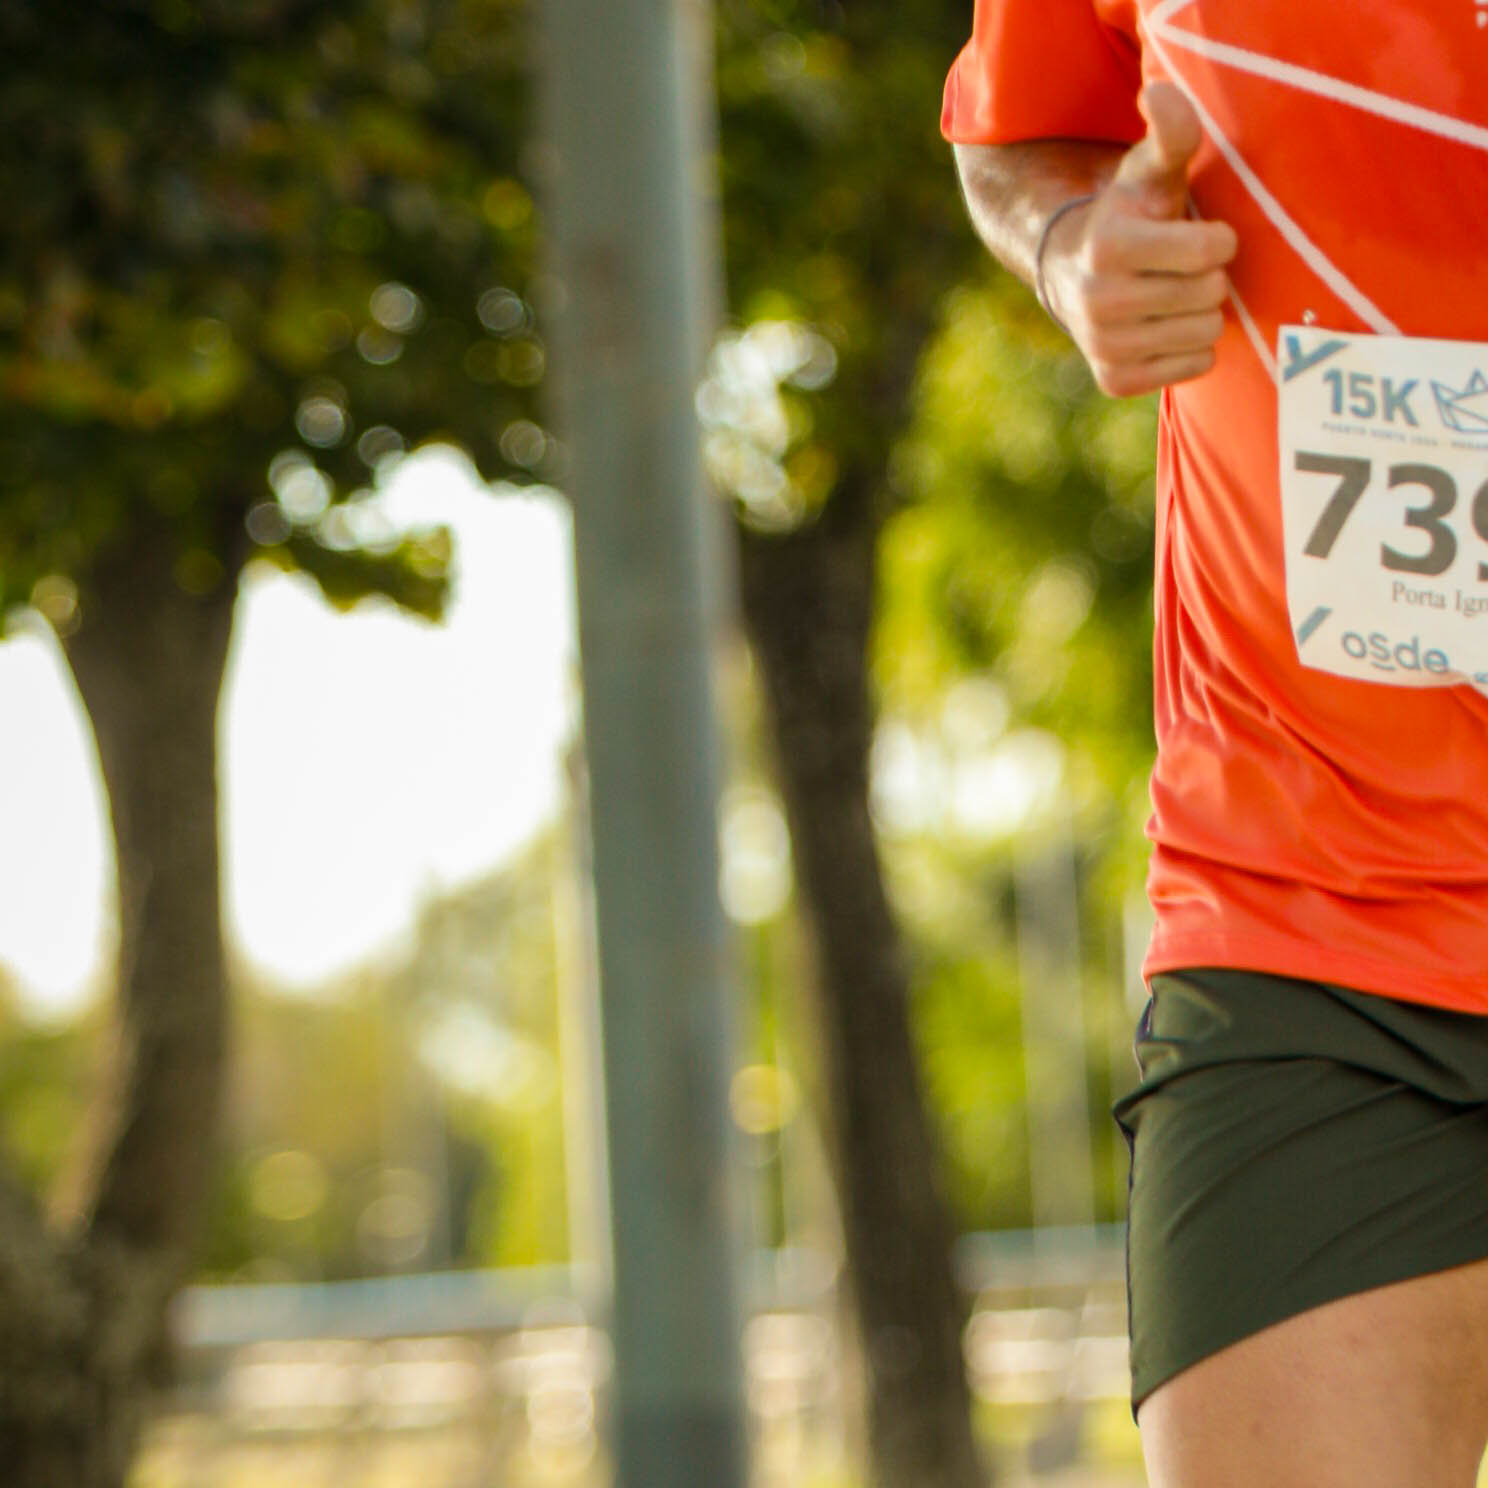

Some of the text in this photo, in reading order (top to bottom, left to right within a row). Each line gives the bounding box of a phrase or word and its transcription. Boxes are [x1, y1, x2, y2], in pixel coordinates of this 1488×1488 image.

[1323, 368, 1419, 426] 15K
[1392, 580, 1447, 609] Porta
[1341, 631, 1450, 673] osde
